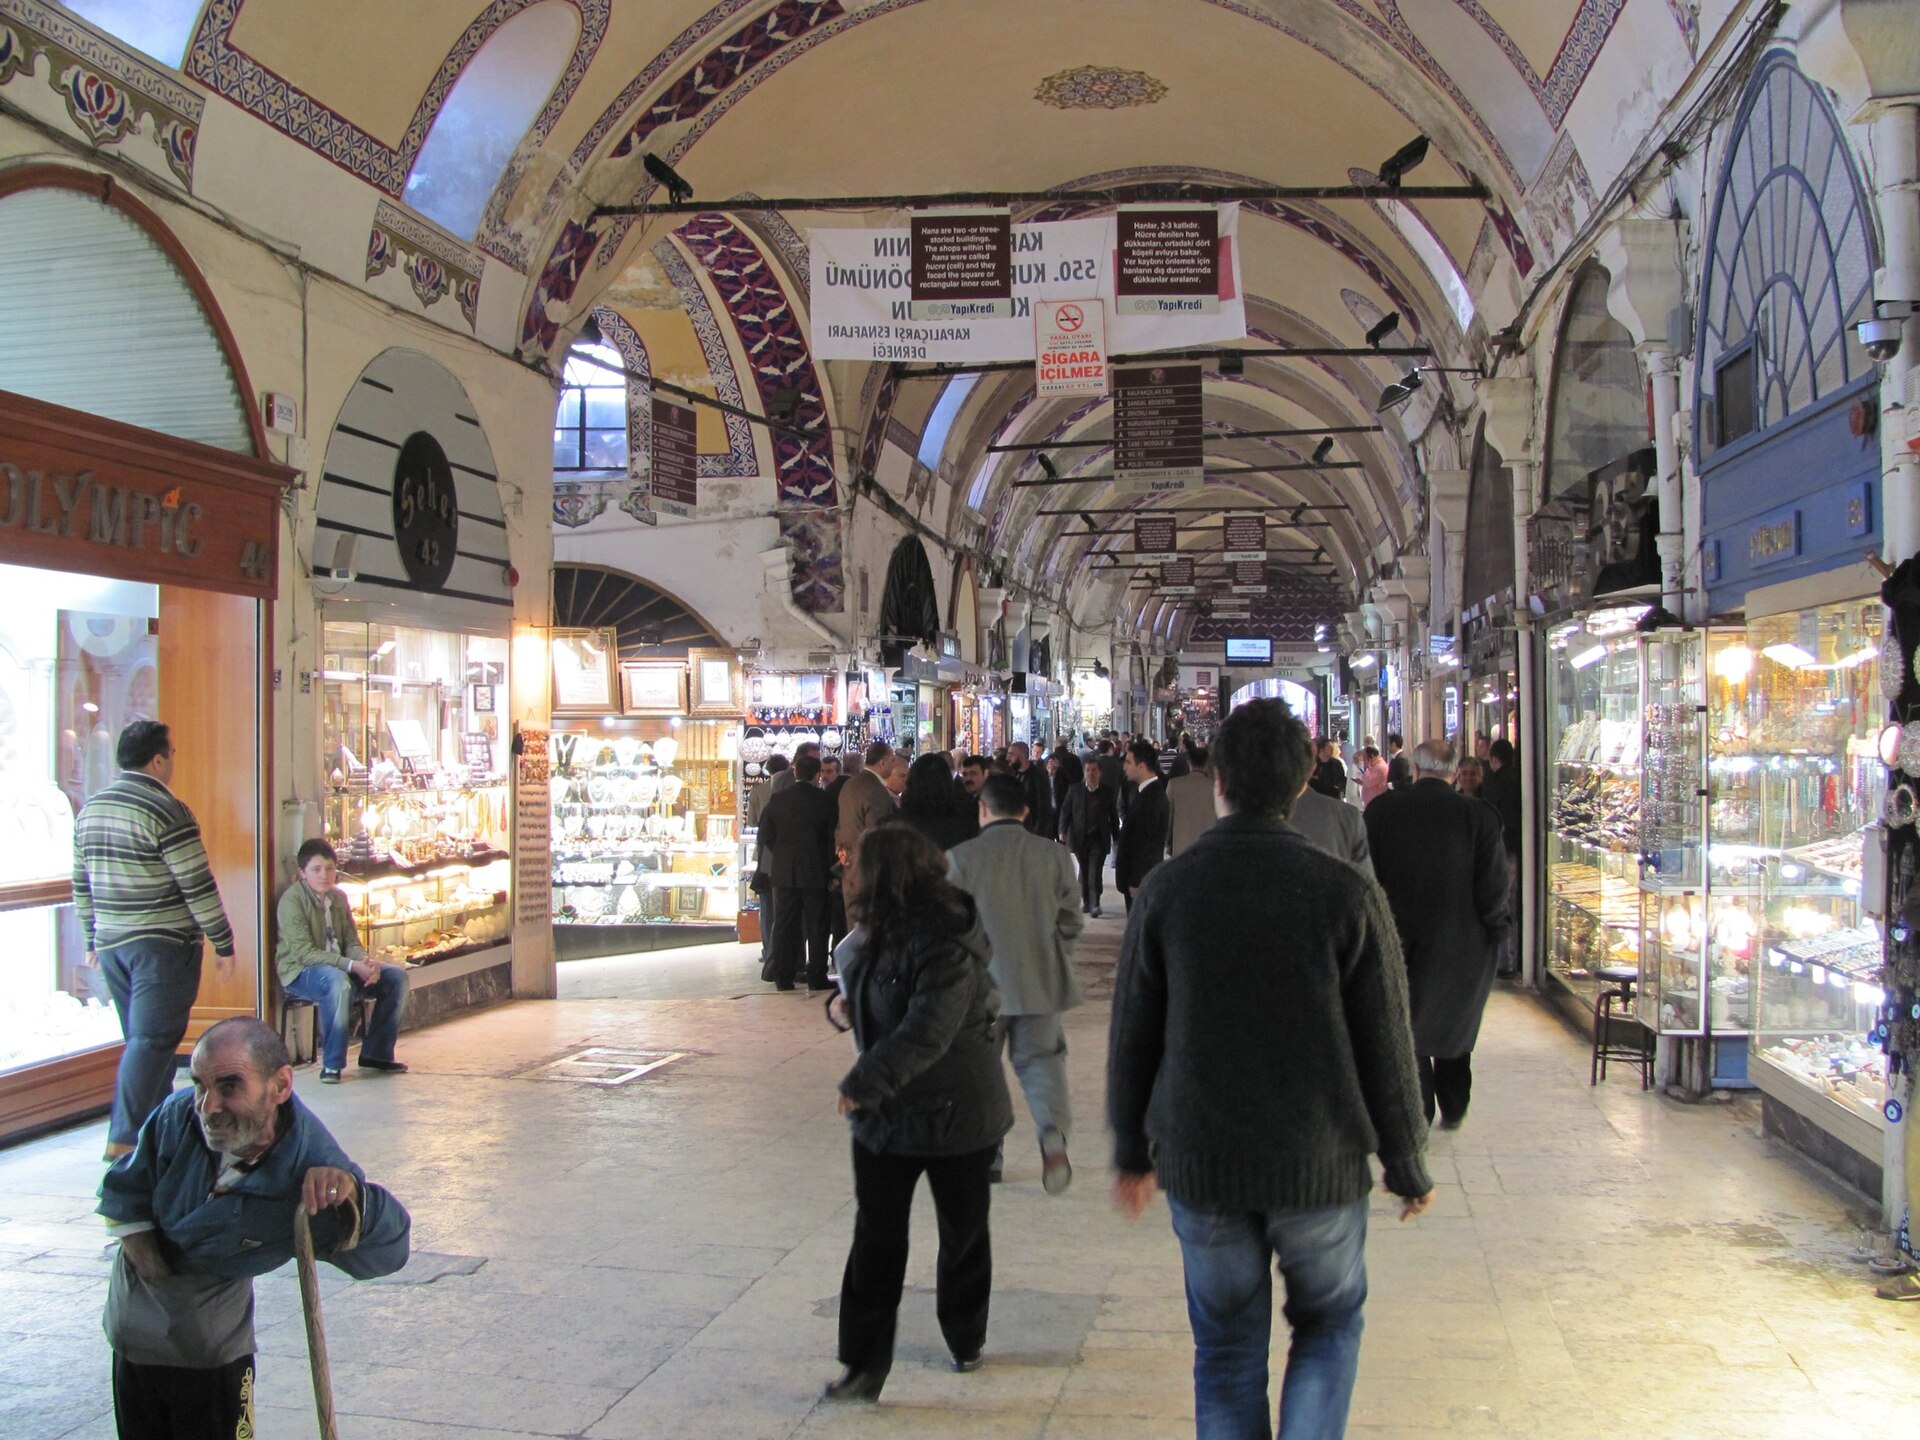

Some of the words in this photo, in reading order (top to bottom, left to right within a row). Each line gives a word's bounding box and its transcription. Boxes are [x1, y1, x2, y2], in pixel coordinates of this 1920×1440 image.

[921, 227, 939, 235] Hans
[956, 235, 990, 244] buildings.
[939, 245, 961, 253] shops
[1132, 249, 1154, 257] köşeli
[1155, 249, 1178, 257] avluya
[980, 262, 996, 270] they
[1138, 258, 1164, 266] kaybını
[1165, 257, 1196, 265] önlemek
[1197, 257, 1211, 265] için
[1153, 267, 1165, 275] dış
[960, 272, 985, 280] square
[920, 280, 959, 289] rectangular
[980, 279, 1001, 287] court.
[950, 302, 995, 315] YapıKredi
[1158, 299, 1202, 311] YapıKredi
[1041, 351, 1100, 365] SİGARA
[1040, 366, 1103, 382] İÇİLMEZ
[0, 462, 204, 558] OLYMPIC
